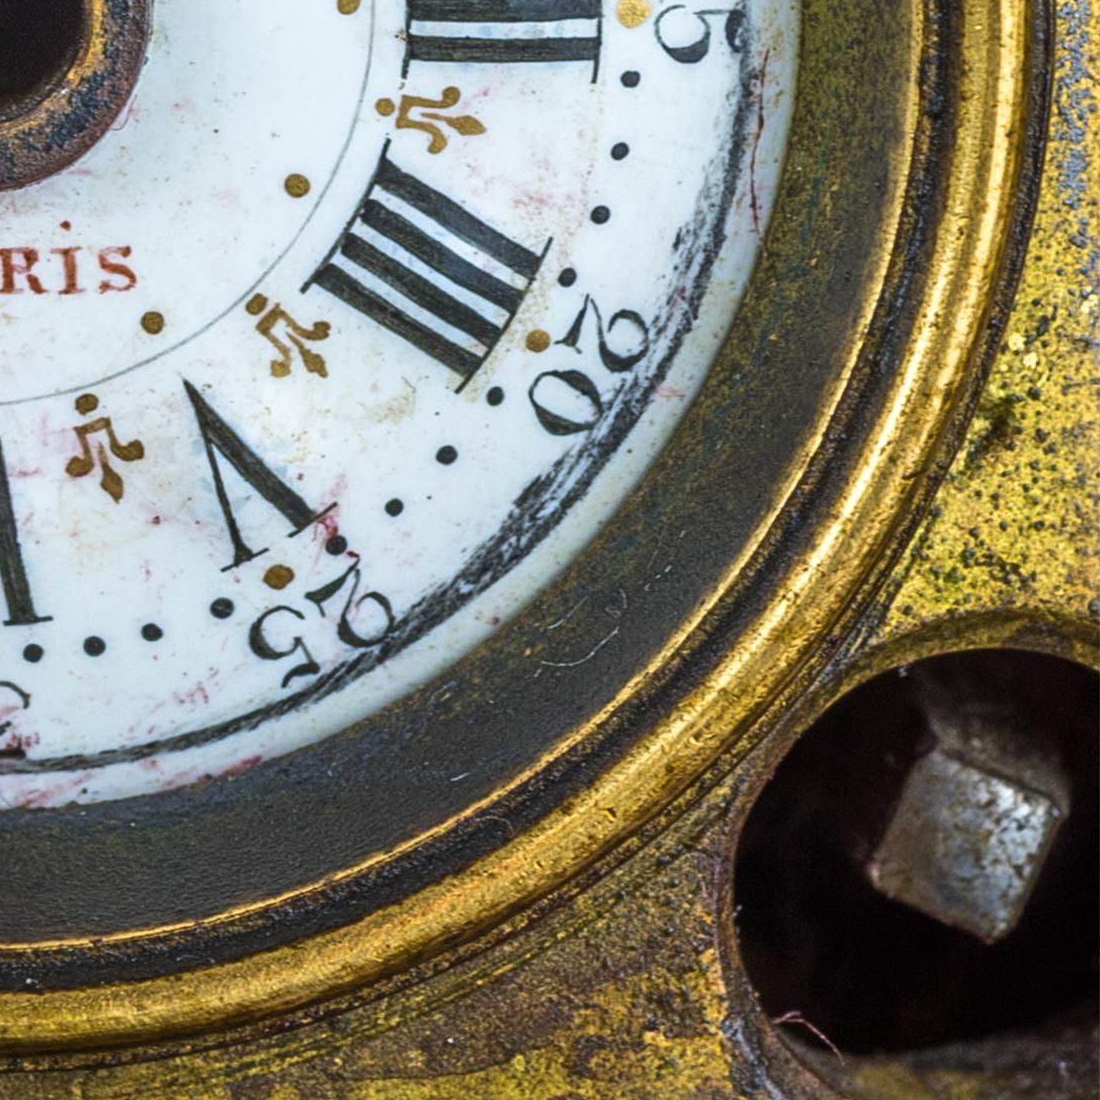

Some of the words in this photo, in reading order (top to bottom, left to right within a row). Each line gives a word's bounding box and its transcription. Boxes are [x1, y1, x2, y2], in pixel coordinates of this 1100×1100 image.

[300, 138, 553, 394] IIII
[528, 294, 649, 436] 20
[182, 374, 338, 572] V
[249, 556, 394, 688] 25
